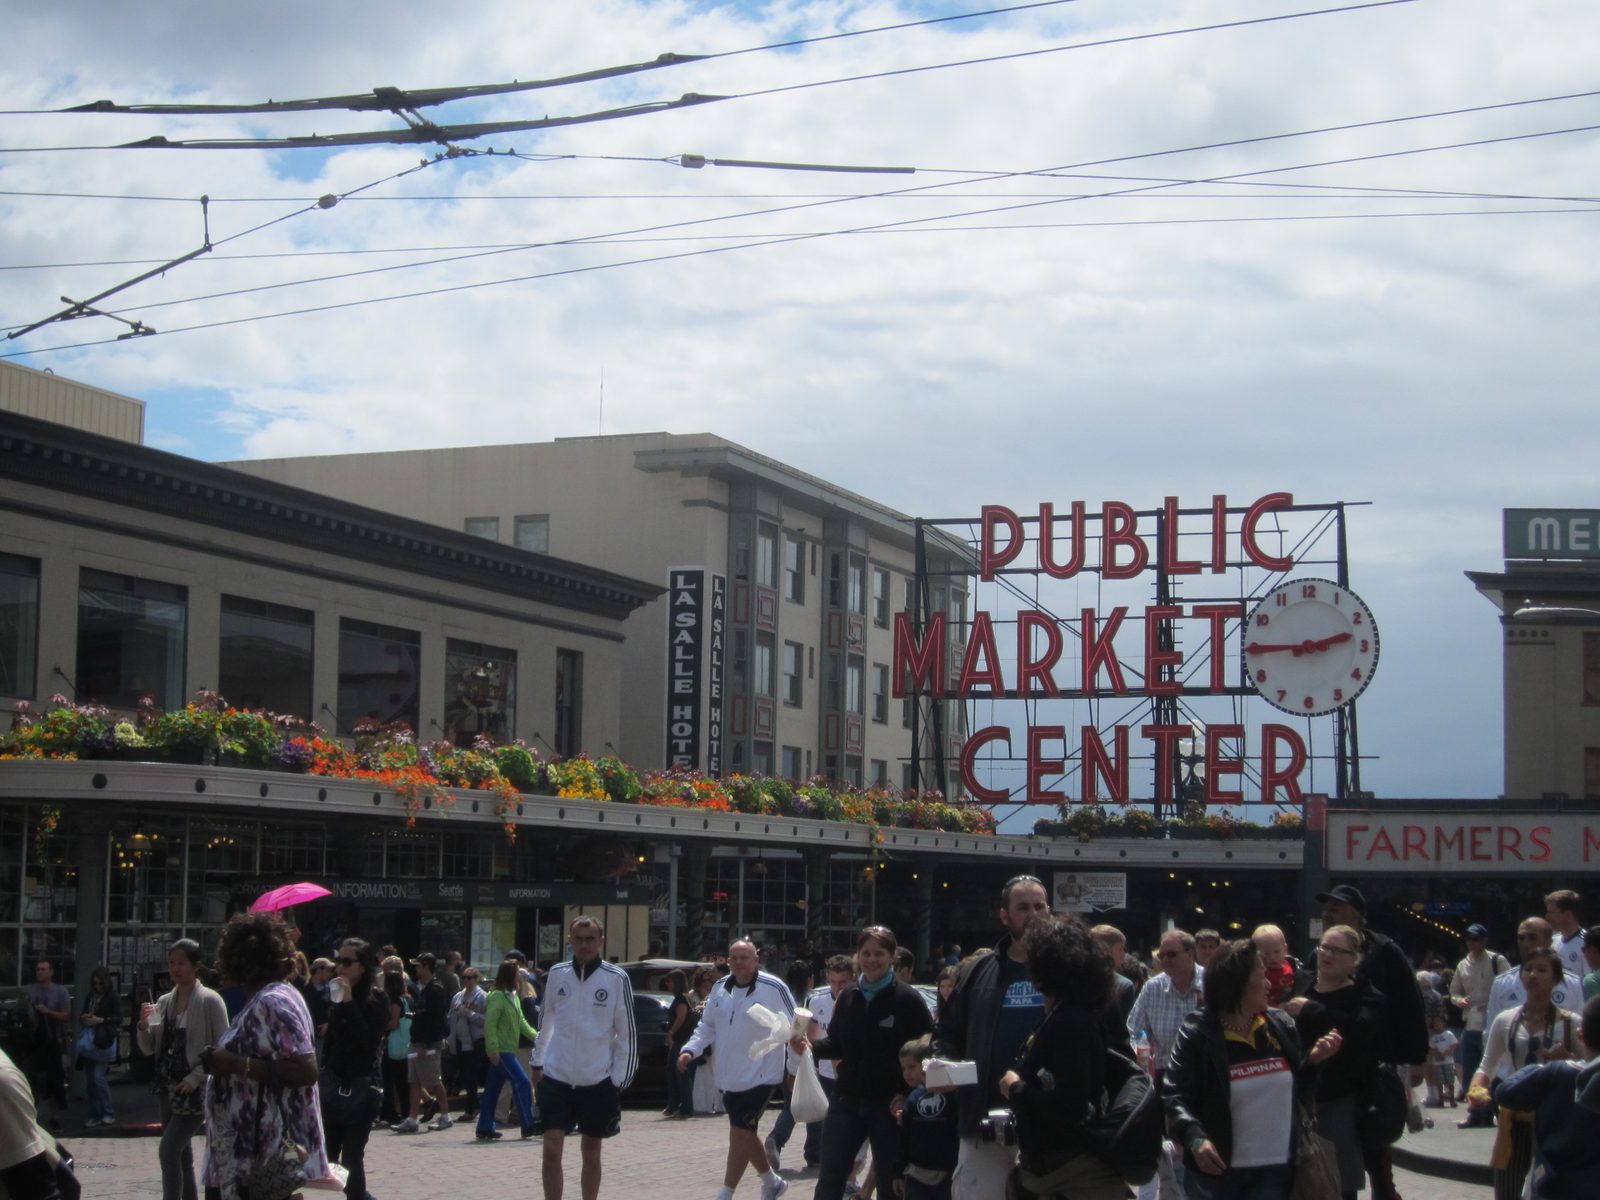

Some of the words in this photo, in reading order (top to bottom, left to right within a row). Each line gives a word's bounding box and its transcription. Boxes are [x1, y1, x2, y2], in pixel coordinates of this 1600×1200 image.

[981, 492, 1294, 582] PUBLIC
[1528, 517, 1600, 550] ME
[675, 575, 696, 605] LA
[714, 578, 723, 610] LA
[1302, 585, 1317, 598] 12
[1276, 593, 1286, 606] 11
[1334, 592, 1339, 605] 1
[1256, 614, 1269, 627] 10
[1353, 611, 1362, 624] 2
[673, 613, 696, 694] SALLE
[893, 604, 1243, 699] MARKET
[1360, 640, 1369, 653] 3
[712, 619, 722, 698] SALLE
[1256, 669, 1266, 683] 8
[1351, 667, 1362, 681] 4
[1277, 690, 1287, 702] 7
[1333, 688, 1343, 701] 5
[1303, 696, 1314, 709] 6
[672, 705, 693, 771] HOTE
[960, 723, 1307, 805] CENTER
[1345, 825, 1553, 862] FARMERS
[333, 883, 407, 898] INFORMATION
[509, 888, 550, 898] INFORMATION
